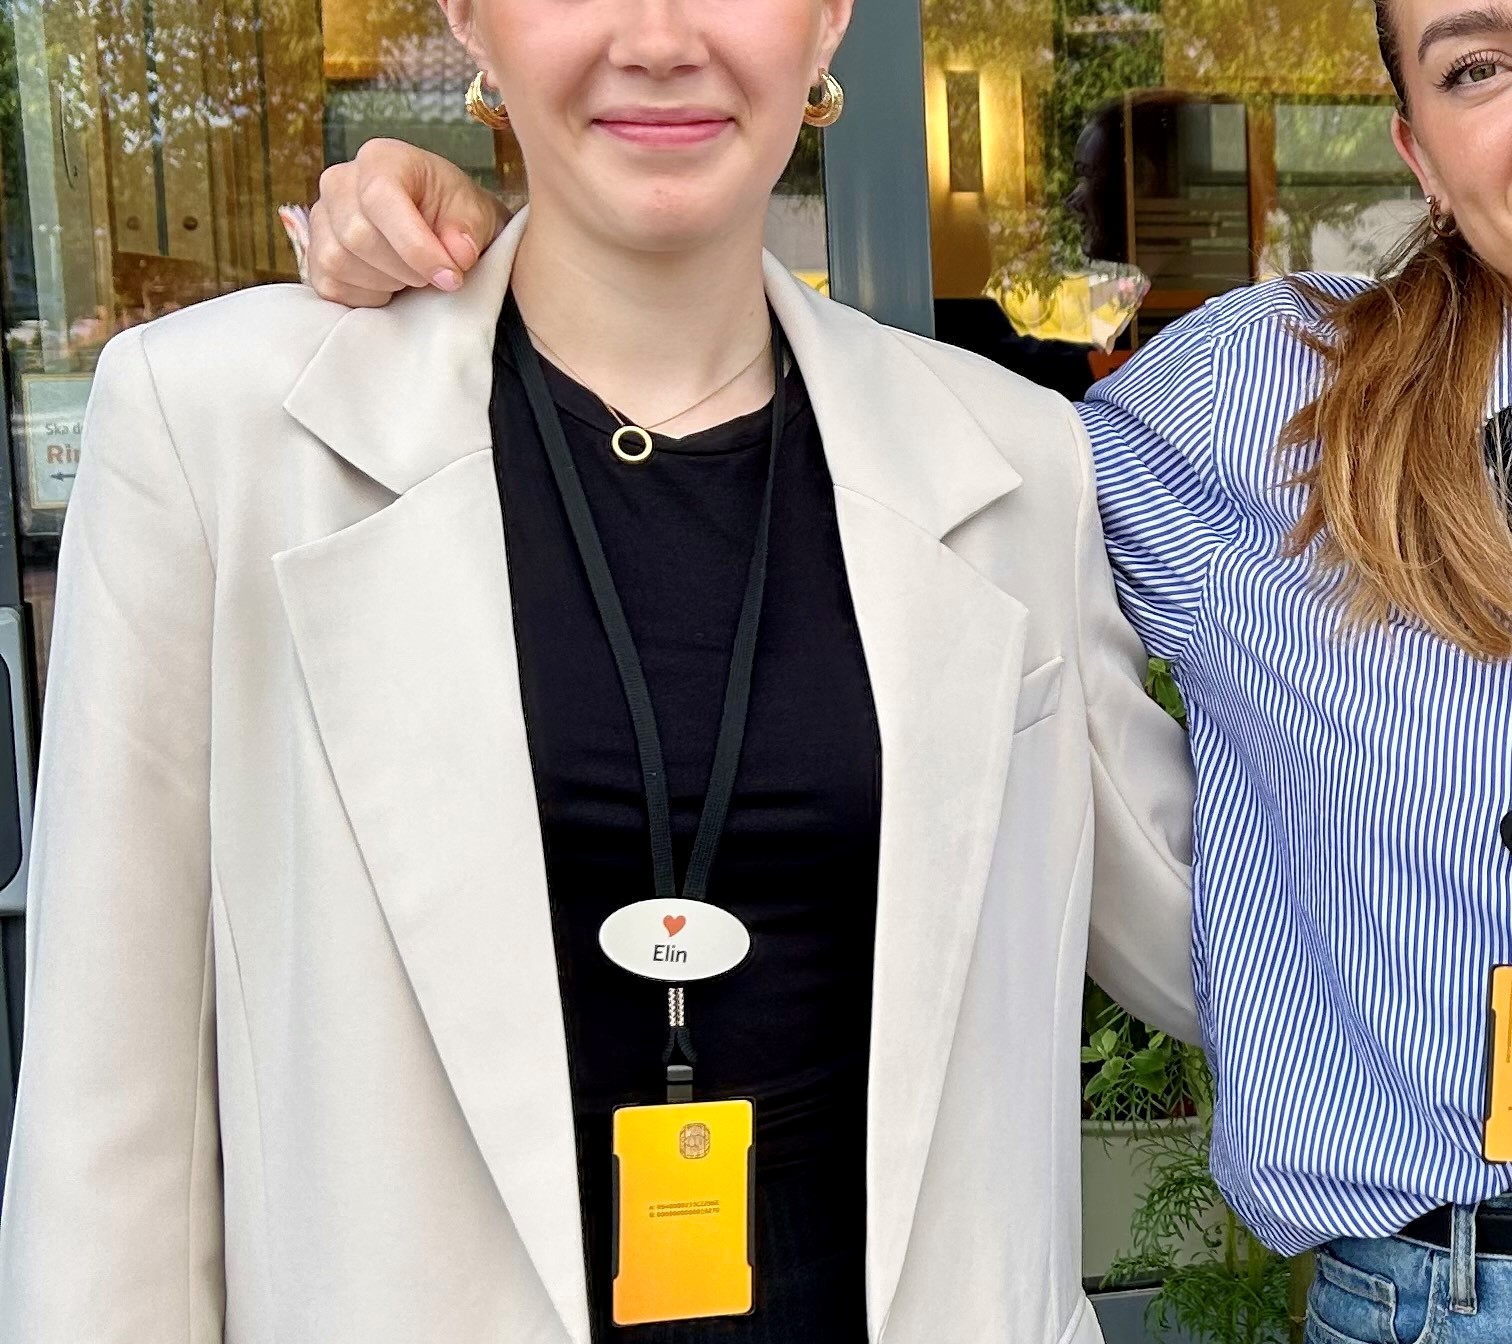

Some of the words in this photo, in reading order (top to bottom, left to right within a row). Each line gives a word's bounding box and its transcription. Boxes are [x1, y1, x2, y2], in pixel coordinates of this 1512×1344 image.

[45, 422, 69, 436] Ska
[72, 422, 83, 435] d
[653, 944, 688, 963] Elin
